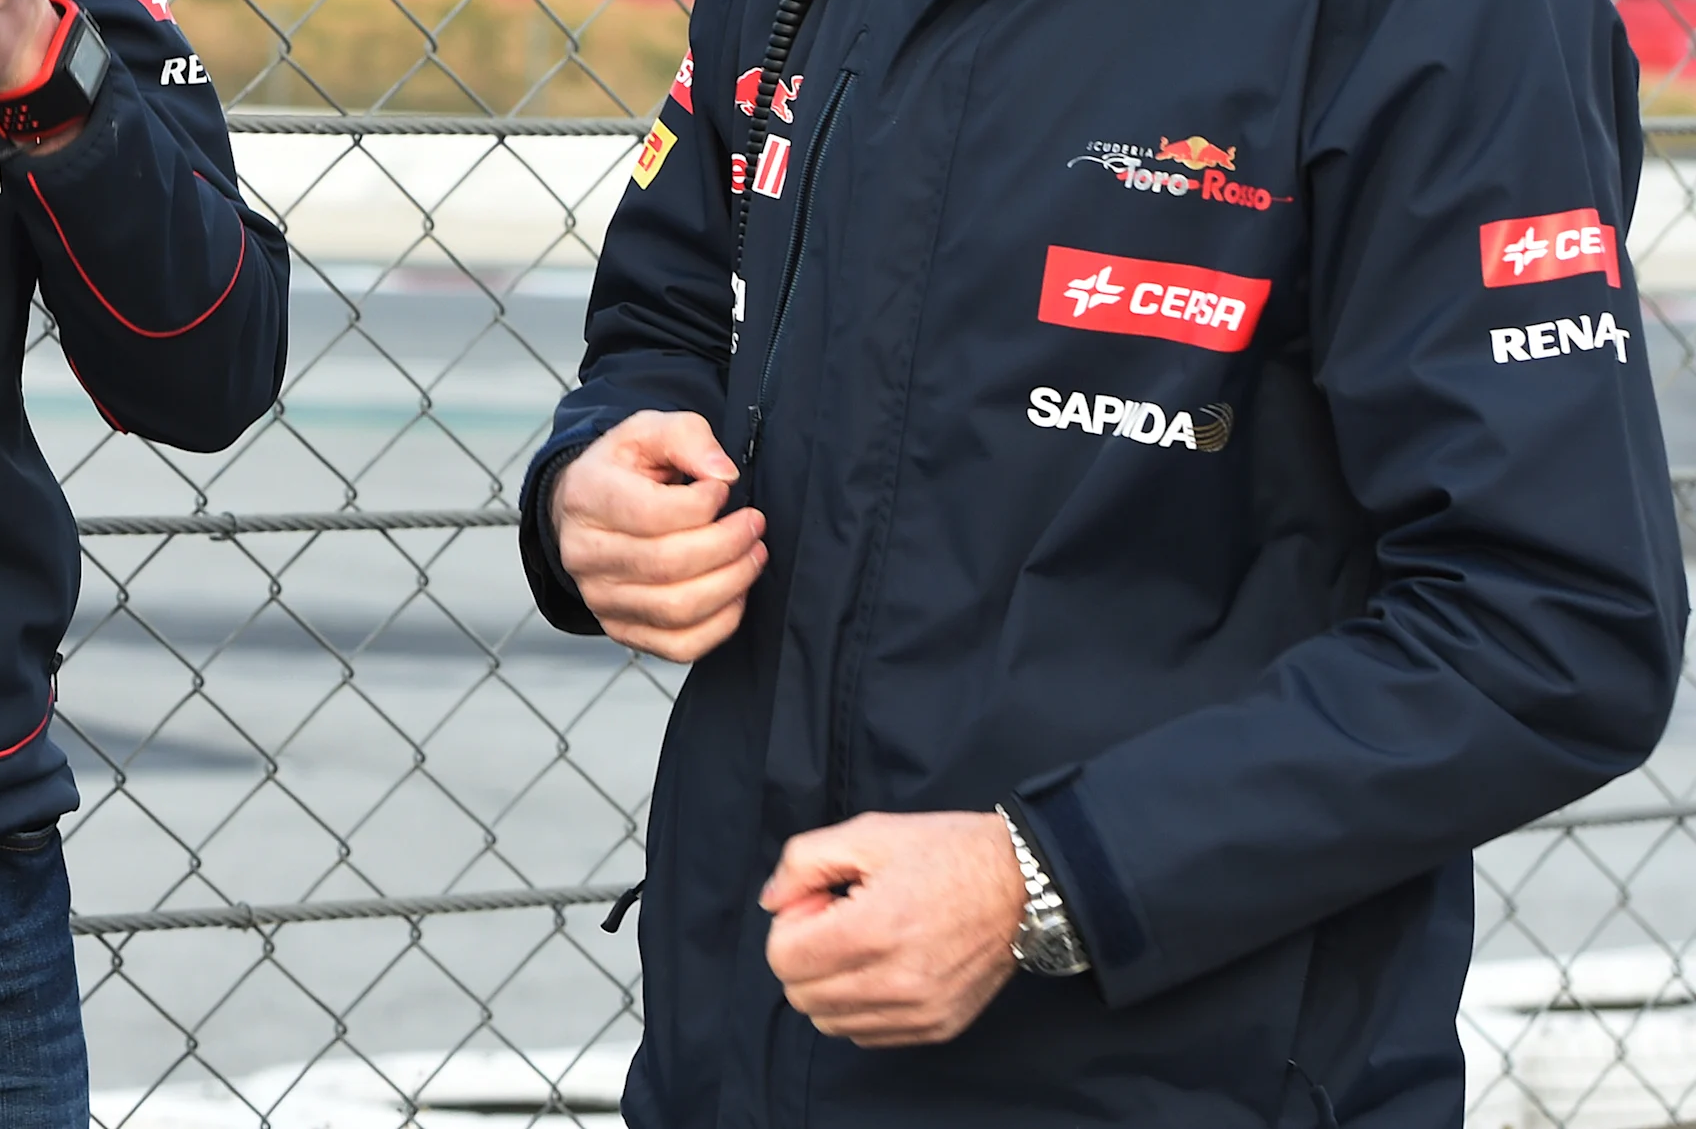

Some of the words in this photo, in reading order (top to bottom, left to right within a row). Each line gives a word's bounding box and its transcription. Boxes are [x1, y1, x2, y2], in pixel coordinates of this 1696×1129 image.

[160, 54, 212, 86] RE
[1085, 140, 1154, 159] SCUDERIA
[1114, 156, 1189, 196] Toro
[1202, 169, 1272, 211] Rosso
[1555, 226, 1605, 261] CE
[1026, 386, 1198, 450] SAPIDA
